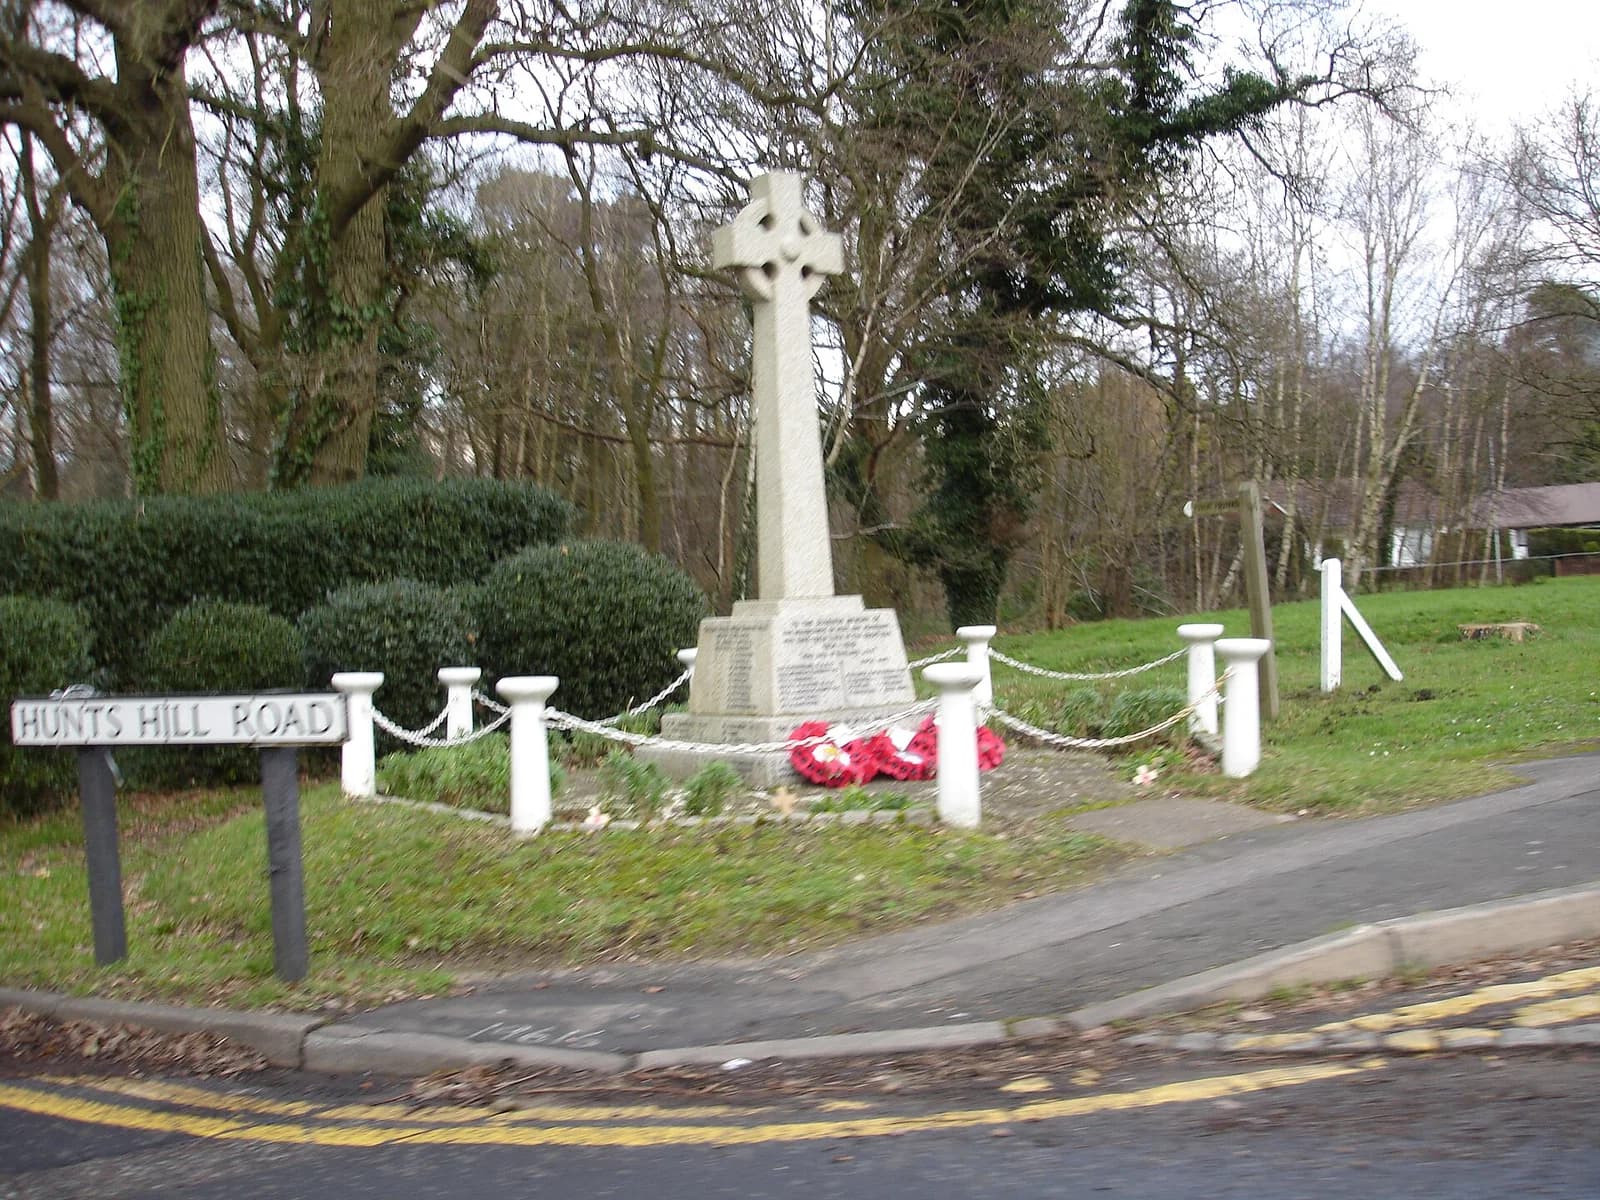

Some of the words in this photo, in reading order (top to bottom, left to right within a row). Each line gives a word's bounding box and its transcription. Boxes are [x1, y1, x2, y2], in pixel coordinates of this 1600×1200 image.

[19, 703, 123, 738] HUNTS
[138, 702, 211, 738] HILL
[232, 699, 336, 737] ROAD
